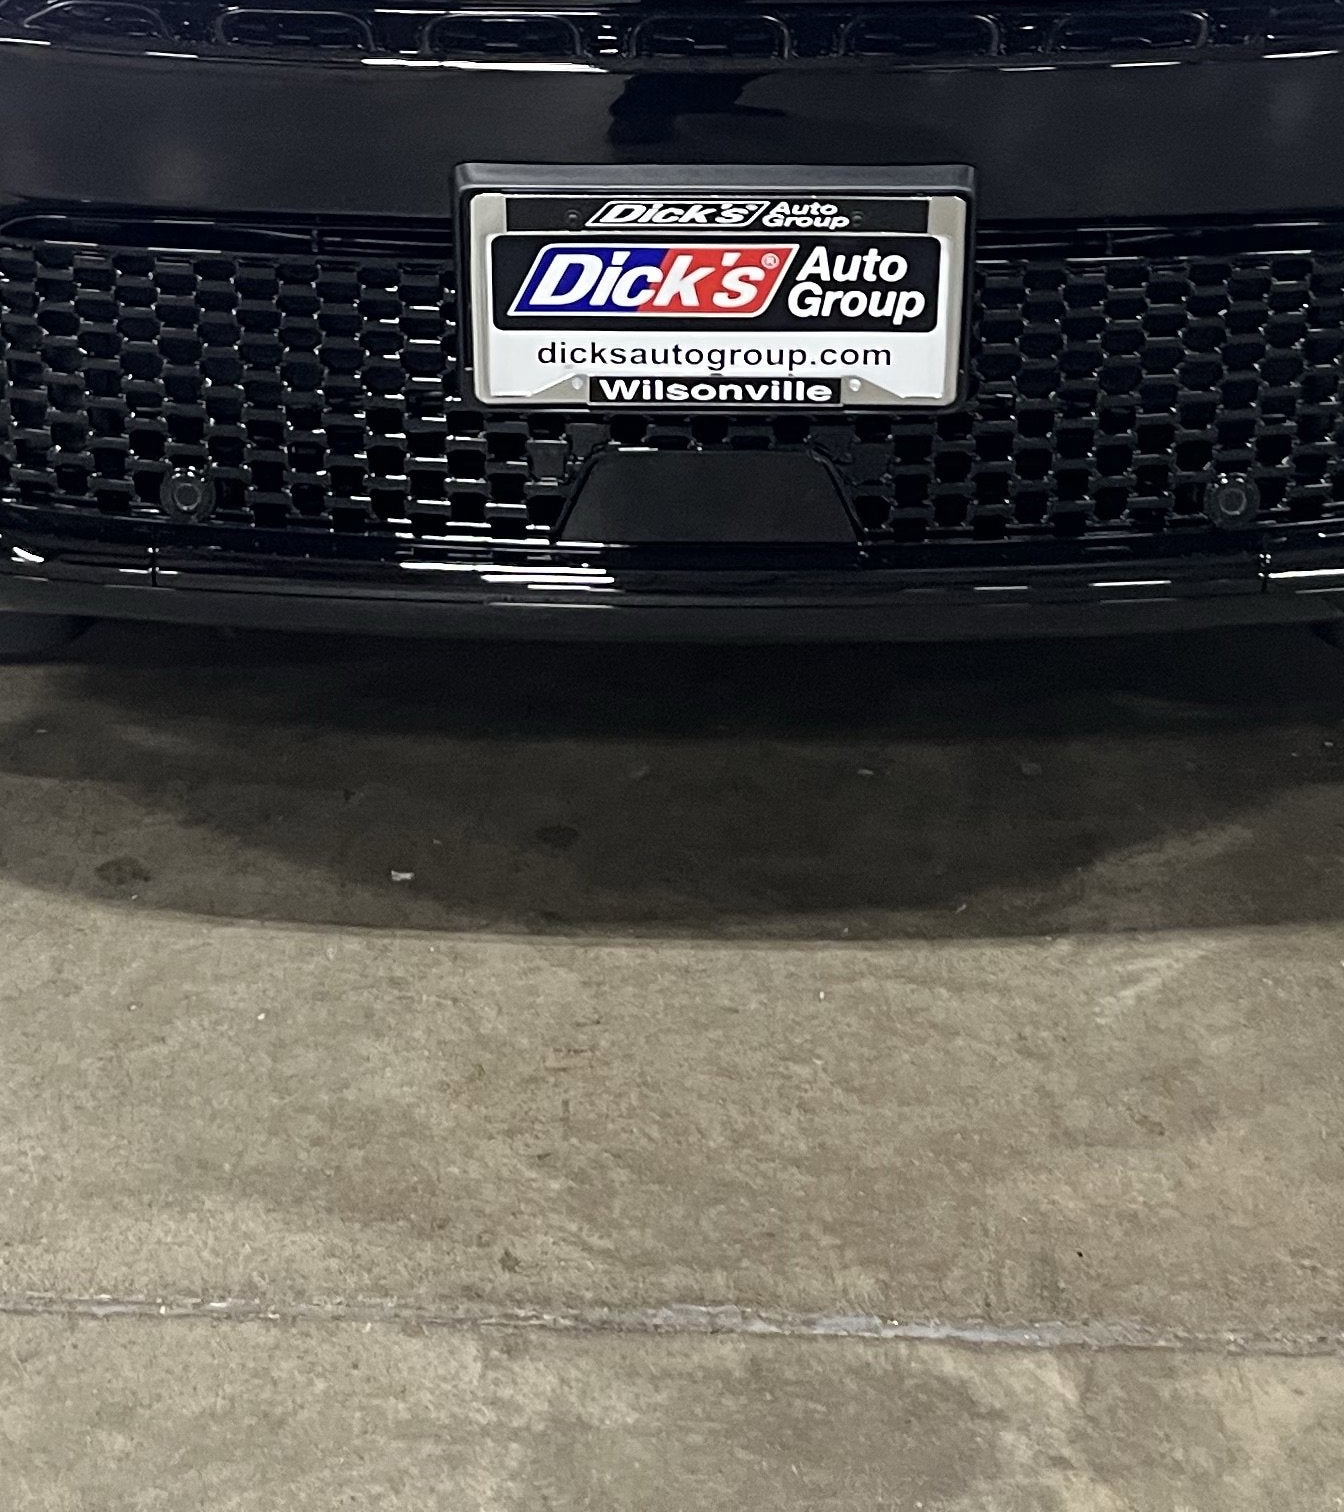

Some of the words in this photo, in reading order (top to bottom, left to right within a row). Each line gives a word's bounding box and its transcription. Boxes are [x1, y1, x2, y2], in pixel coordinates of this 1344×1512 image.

[763, 214, 850, 230] Group
[775, 202, 838, 216] Auto
[796, 246, 908, 282] Auto
[788, 281, 926, 325] Group
[538, 342, 892, 371] dicksautogroup.com
[598, 379, 833, 402] Wilsonville
